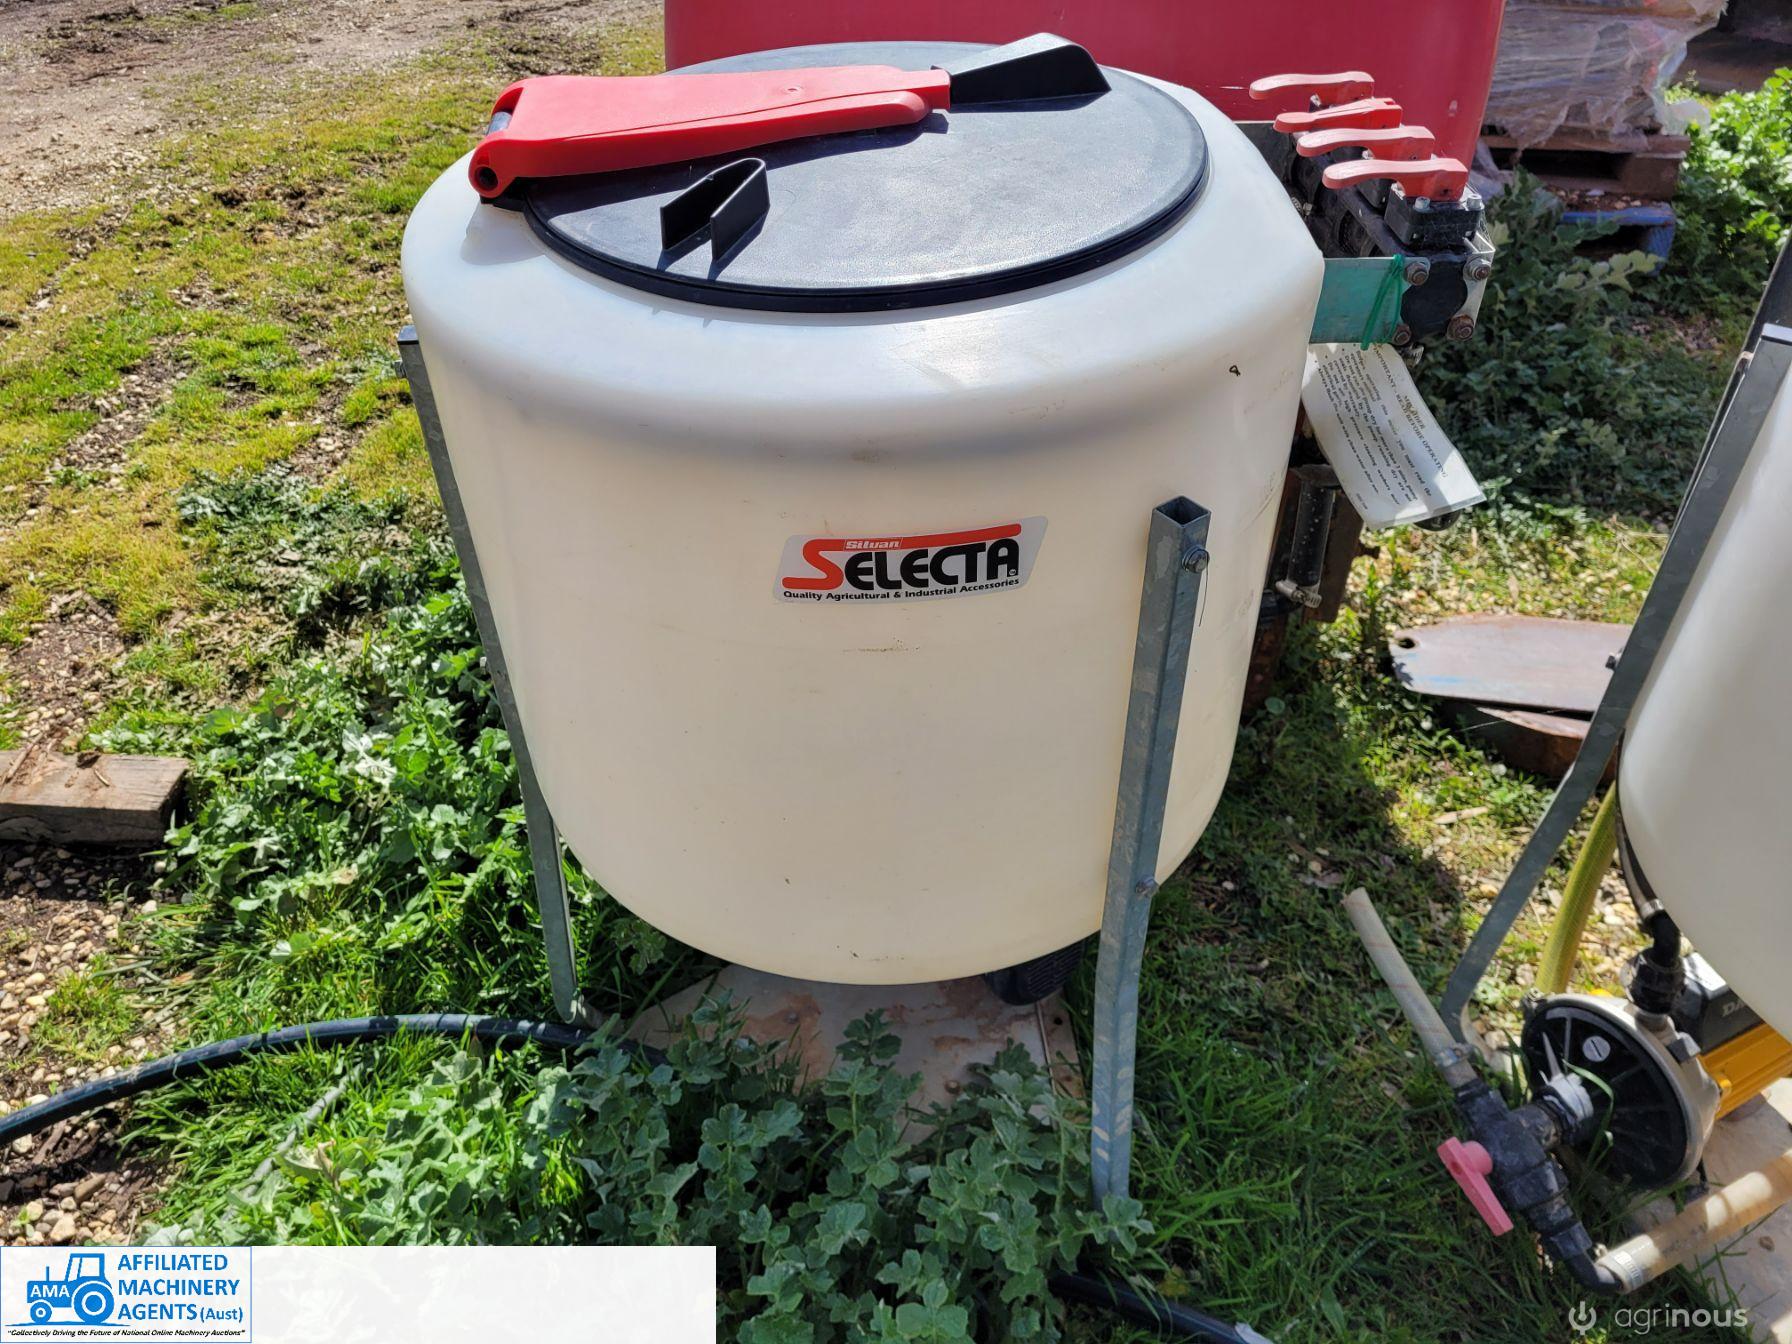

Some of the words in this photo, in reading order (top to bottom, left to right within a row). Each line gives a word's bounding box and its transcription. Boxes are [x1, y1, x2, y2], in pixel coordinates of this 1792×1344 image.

[782, 523, 1021, 591] SELECTA
[783, 590, 822, 601] Quality
[826, 590, 890, 601] Agricultural
[893, 590, 901, 598] &
[904, 587, 957, 598] Industrial
[959, 577, 1020, 593] Accessories
